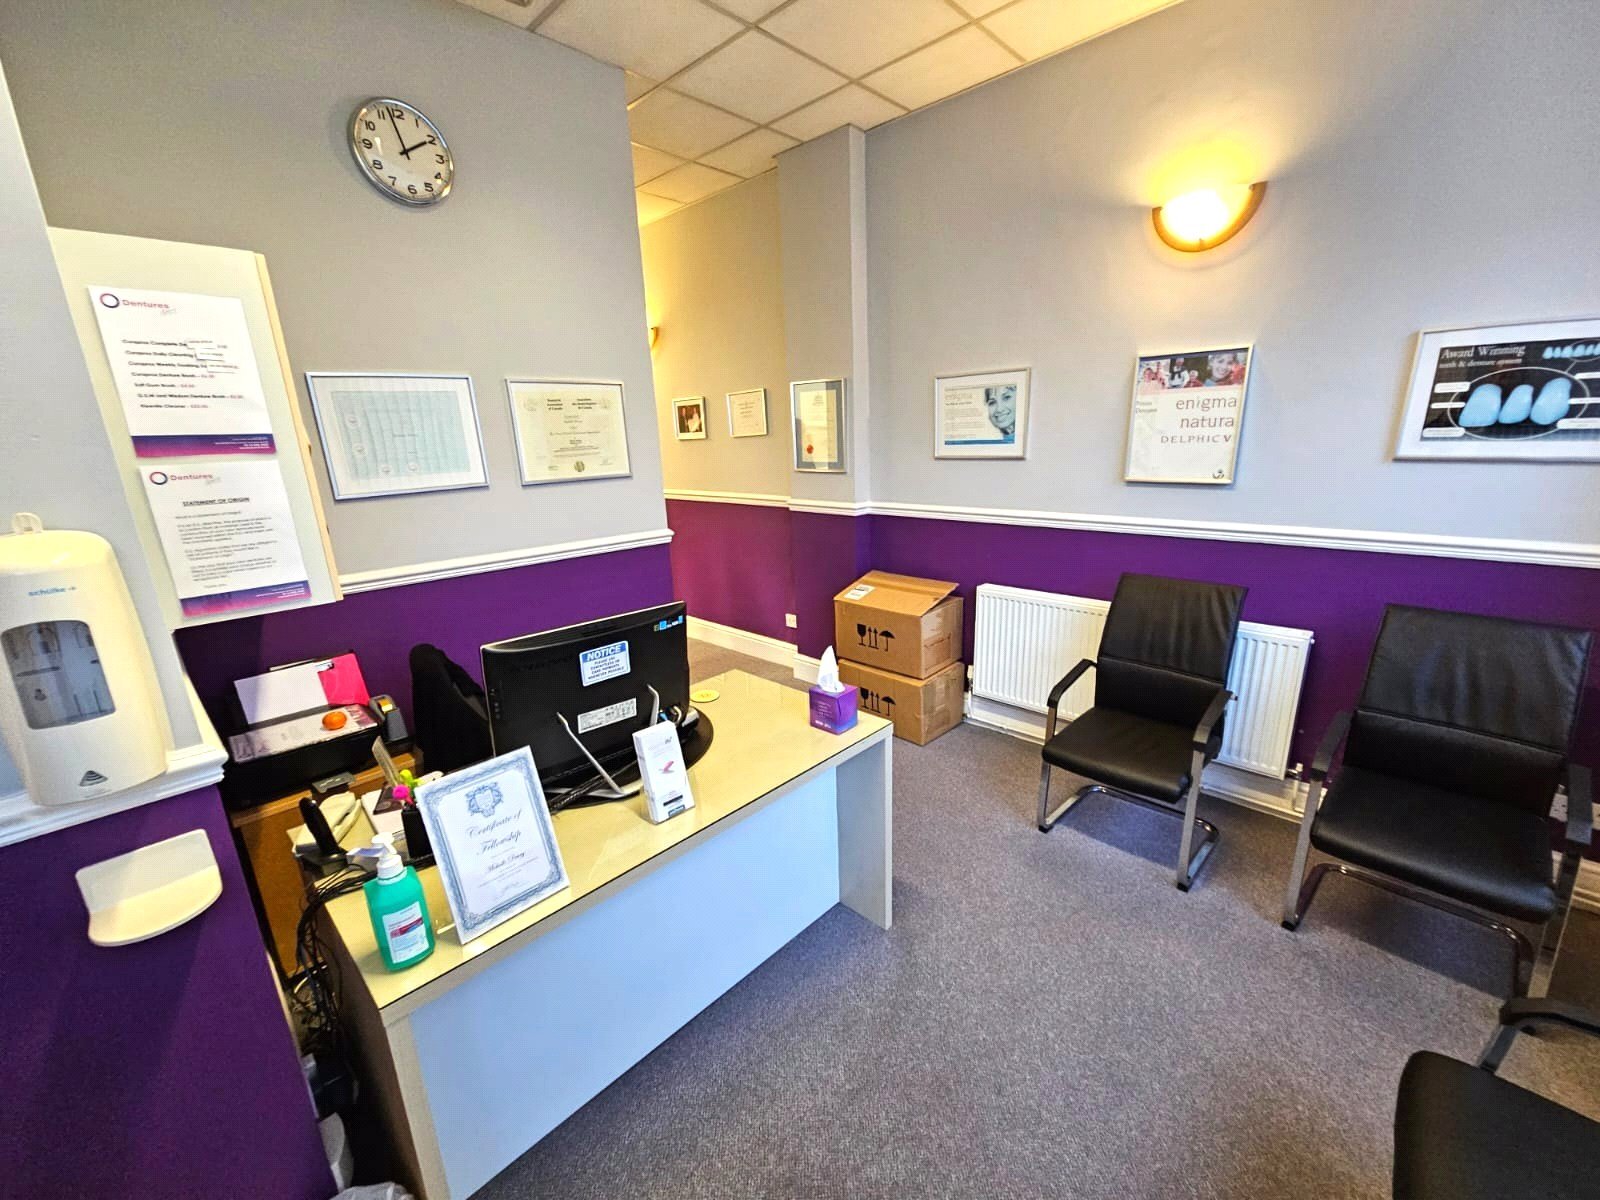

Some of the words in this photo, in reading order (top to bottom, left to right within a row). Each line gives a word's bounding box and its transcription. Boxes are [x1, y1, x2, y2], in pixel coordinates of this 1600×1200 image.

[377, 109, 386, 120] 11
[391, 108, 405, 120] 12
[365, 120, 376, 131] 10
[415, 119, 420, 128] 1
[362, 139, 373, 149] 9
[427, 134, 437, 146] 2
[435, 154, 445, 164] 3
[372, 160, 383, 170] 8
[388, 176, 397, 186] 7
[434, 172, 443, 180] 4
[408, 184, 417, 195] 6
[424, 182, 434, 192] 5
[122, 300, 170, 309] Dentures
[1441, 346, 1475, 359] Award
[1477, 345, 1526, 357] Winning
[1176, 395, 1237, 412] enigma
[1180, 415, 1235, 429] natura
[1160, 434, 1221, 444] DELPHIC
[170, 473, 213, 482] Dentures
[587, 645, 621, 661] NOTICE
[466, 816, 512, 840] Certificate
[512, 808, 523, 822] of
[477, 829, 521, 855] Fellowship
